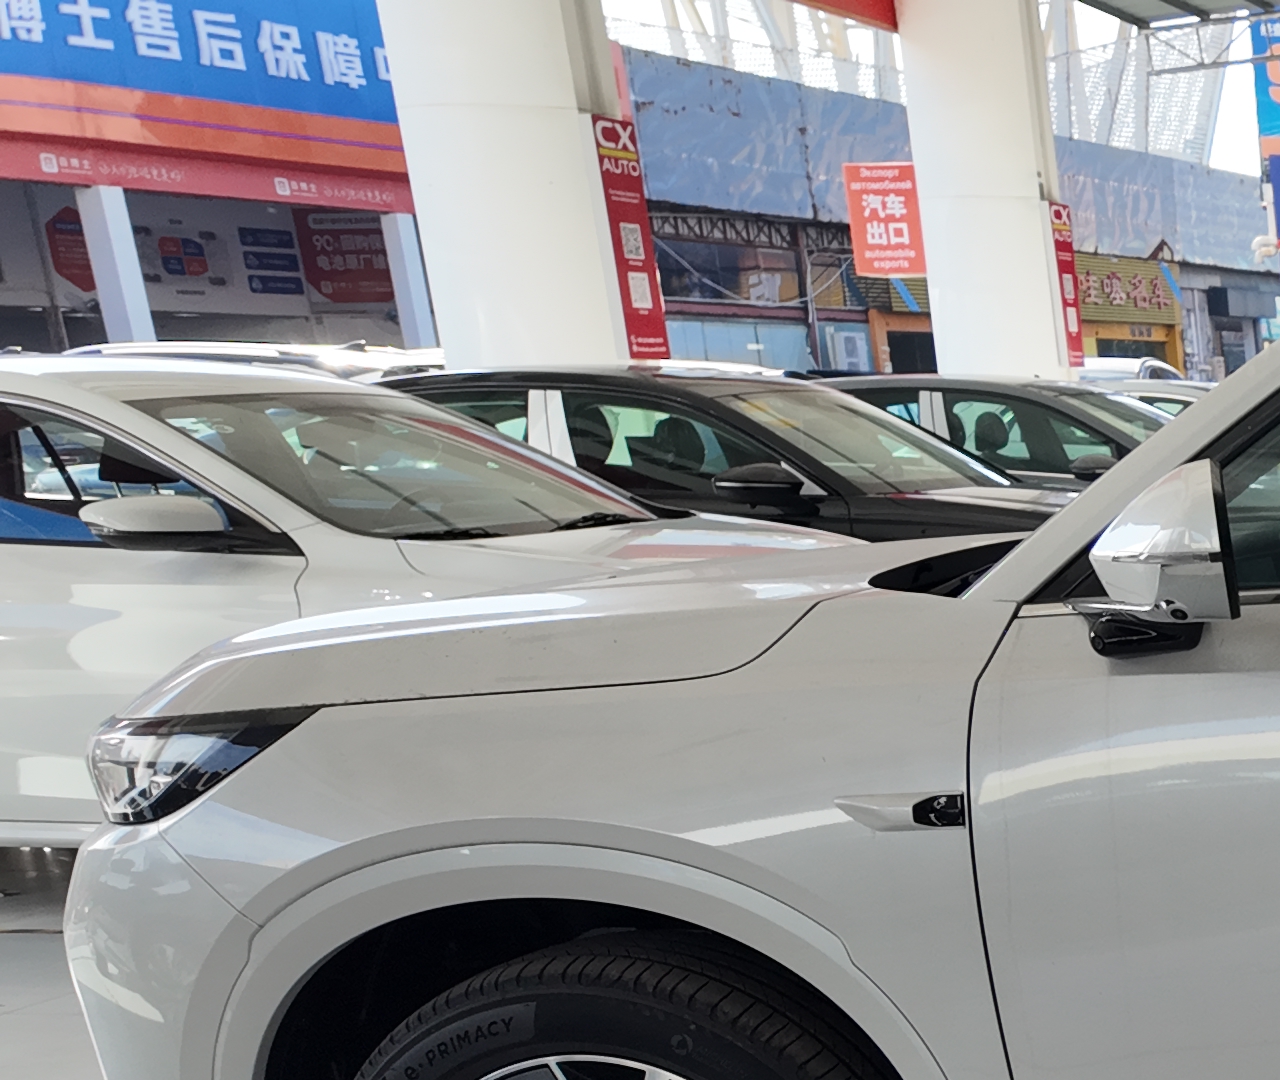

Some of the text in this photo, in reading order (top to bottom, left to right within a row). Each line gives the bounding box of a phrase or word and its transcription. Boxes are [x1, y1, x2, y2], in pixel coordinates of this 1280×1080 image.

[595, 120, 636, 152] CX
[602, 157, 640, 177] AUTO
[859, 168, 899, 178] Экспорт
[861, 193, 907, 218] 汽车
[1050, 205, 1070, 226] CX
[866, 221, 910, 245] 出口
[1054, 231, 1072, 243] AUTO
[864, 249, 916, 258] automobile
[873, 260, 910, 269] exports
